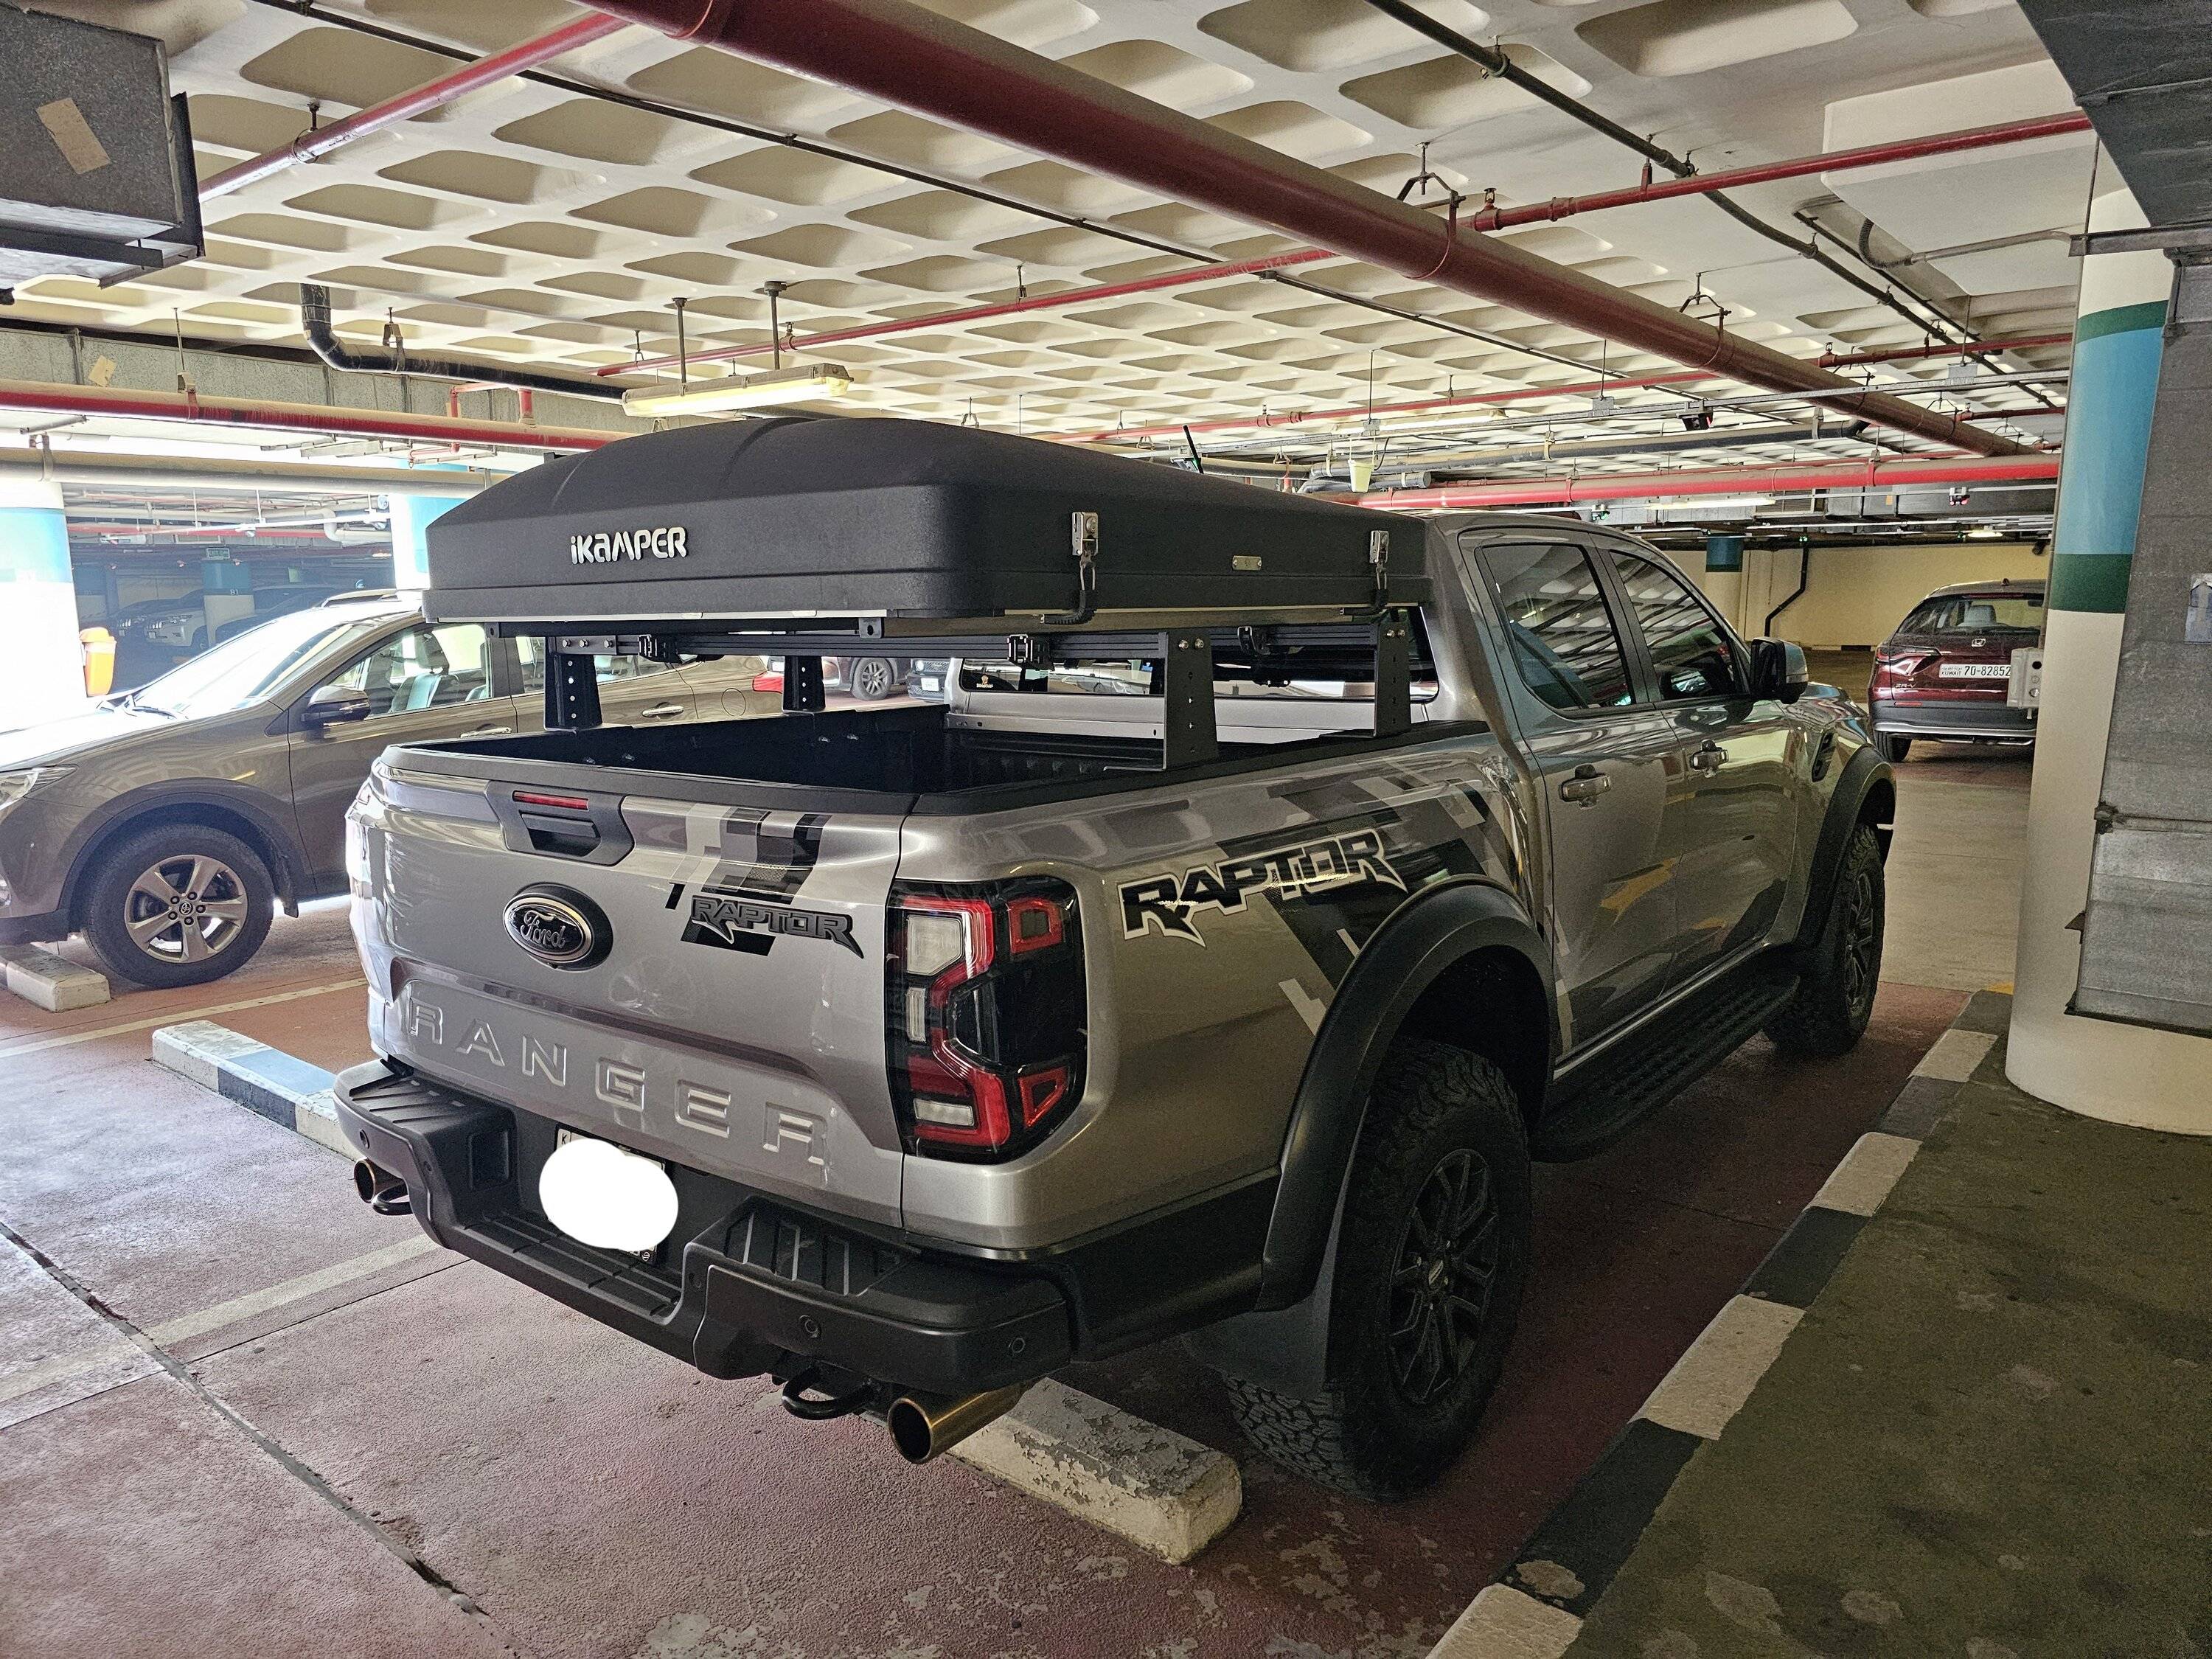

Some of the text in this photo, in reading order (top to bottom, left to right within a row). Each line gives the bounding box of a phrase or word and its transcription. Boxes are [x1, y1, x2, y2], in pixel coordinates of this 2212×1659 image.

[1964, 666, 2011, 676] 70-82852
[1118, 828, 1408, 947] RAPTOR
[521, 910, 566, 949] Ford
[691, 894, 864, 959] RAPTOR
[408, 995, 827, 1166] RANGER
